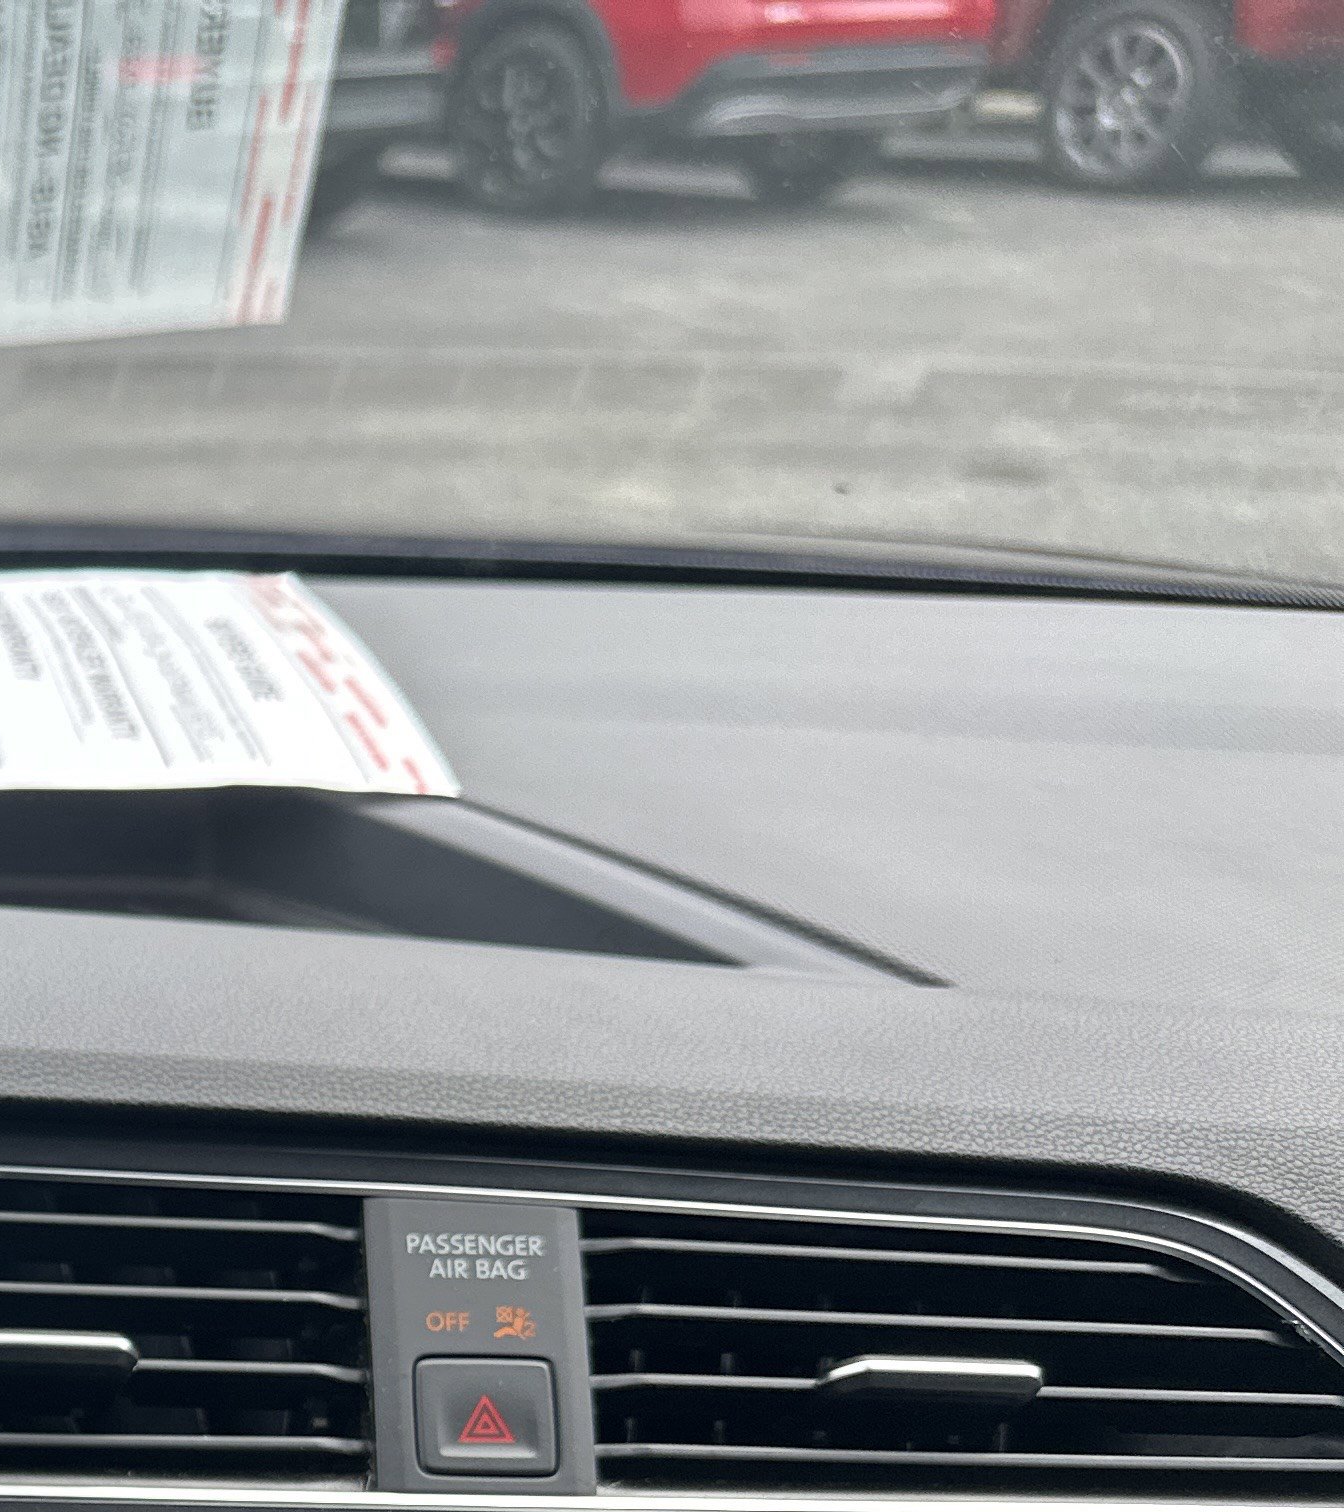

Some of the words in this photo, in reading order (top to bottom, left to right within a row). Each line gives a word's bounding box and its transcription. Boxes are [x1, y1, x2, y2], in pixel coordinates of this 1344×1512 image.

[405, 1232, 544, 1257] PASSENGER
[429, 1258, 469, 1280] AIR
[475, 1259, 528, 1281] BAG
[425, 1311, 471, 1333] OFF
